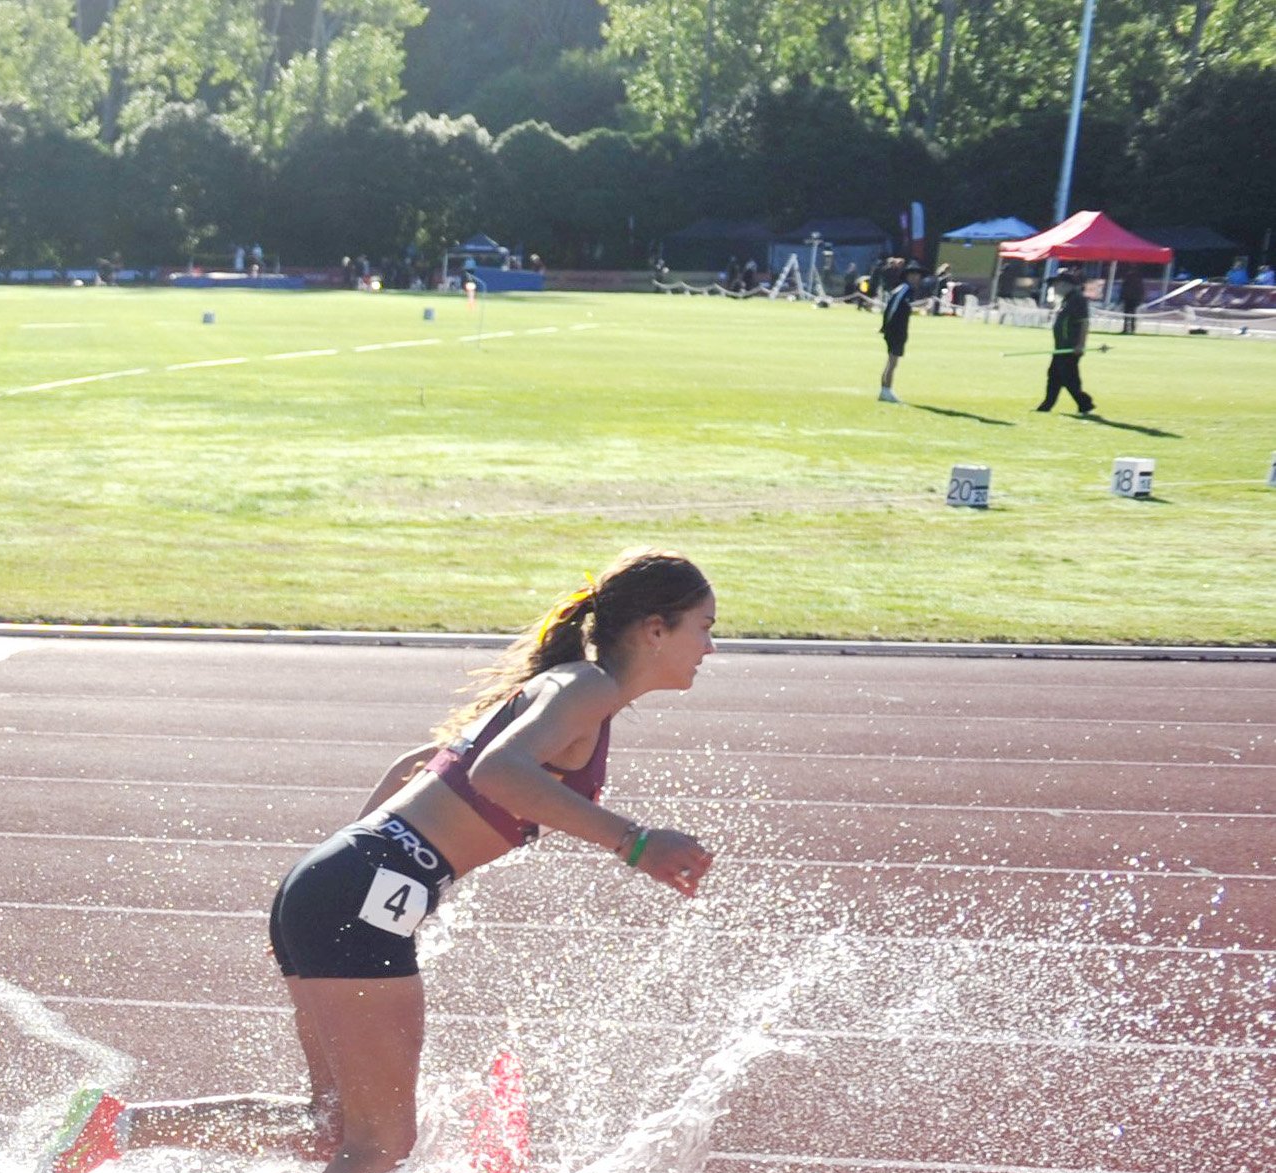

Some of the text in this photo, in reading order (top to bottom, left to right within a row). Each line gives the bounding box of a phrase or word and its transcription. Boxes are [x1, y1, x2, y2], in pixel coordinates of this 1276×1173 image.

[947, 478, 973, 501] 20
[1114, 469, 1134, 492] 18
[378, 819, 439, 870] PRO
[383, 883, 412, 923] 4
